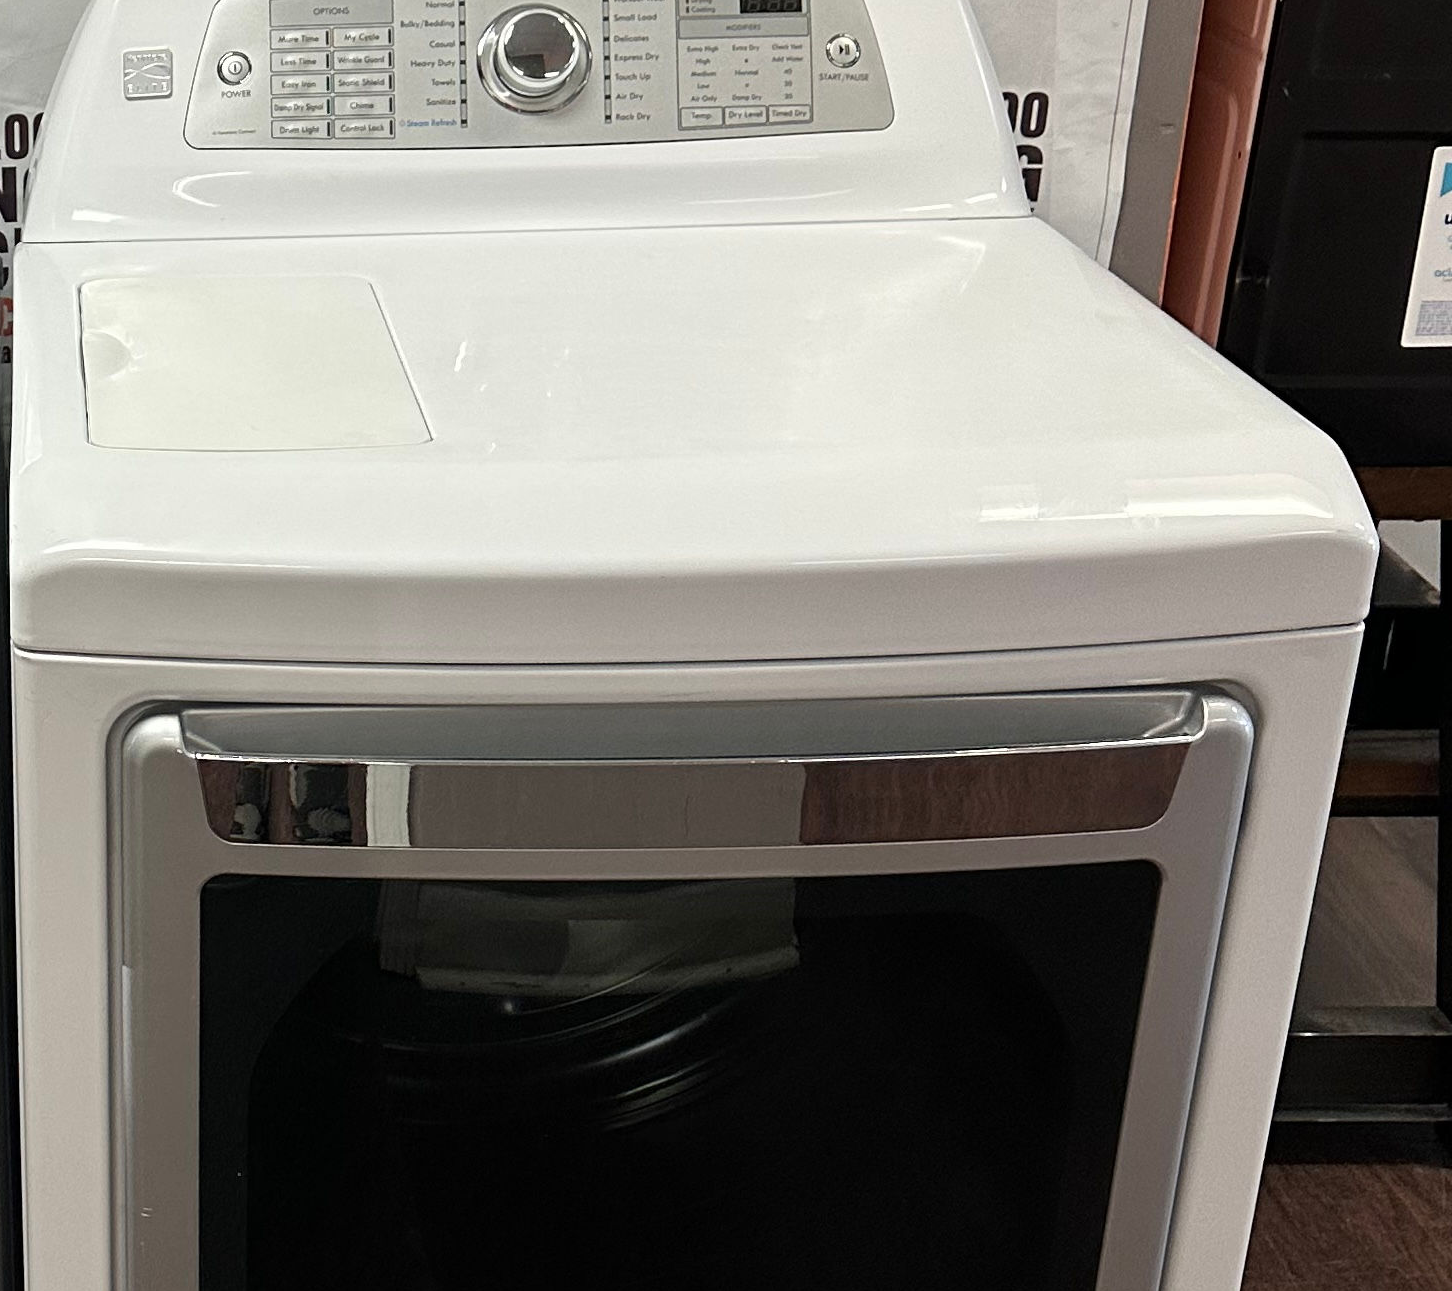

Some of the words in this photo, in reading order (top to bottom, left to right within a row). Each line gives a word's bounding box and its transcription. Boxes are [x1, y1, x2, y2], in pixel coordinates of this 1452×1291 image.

[313, 7, 350, 15] OPTIONS
[645, 53, 659, 61] Dry
[410, 60, 435, 68] Heavy
[432, 78, 456, 86] Towels
[221, 90, 252, 98] POWER
[629, 92, 644, 100] Dry
